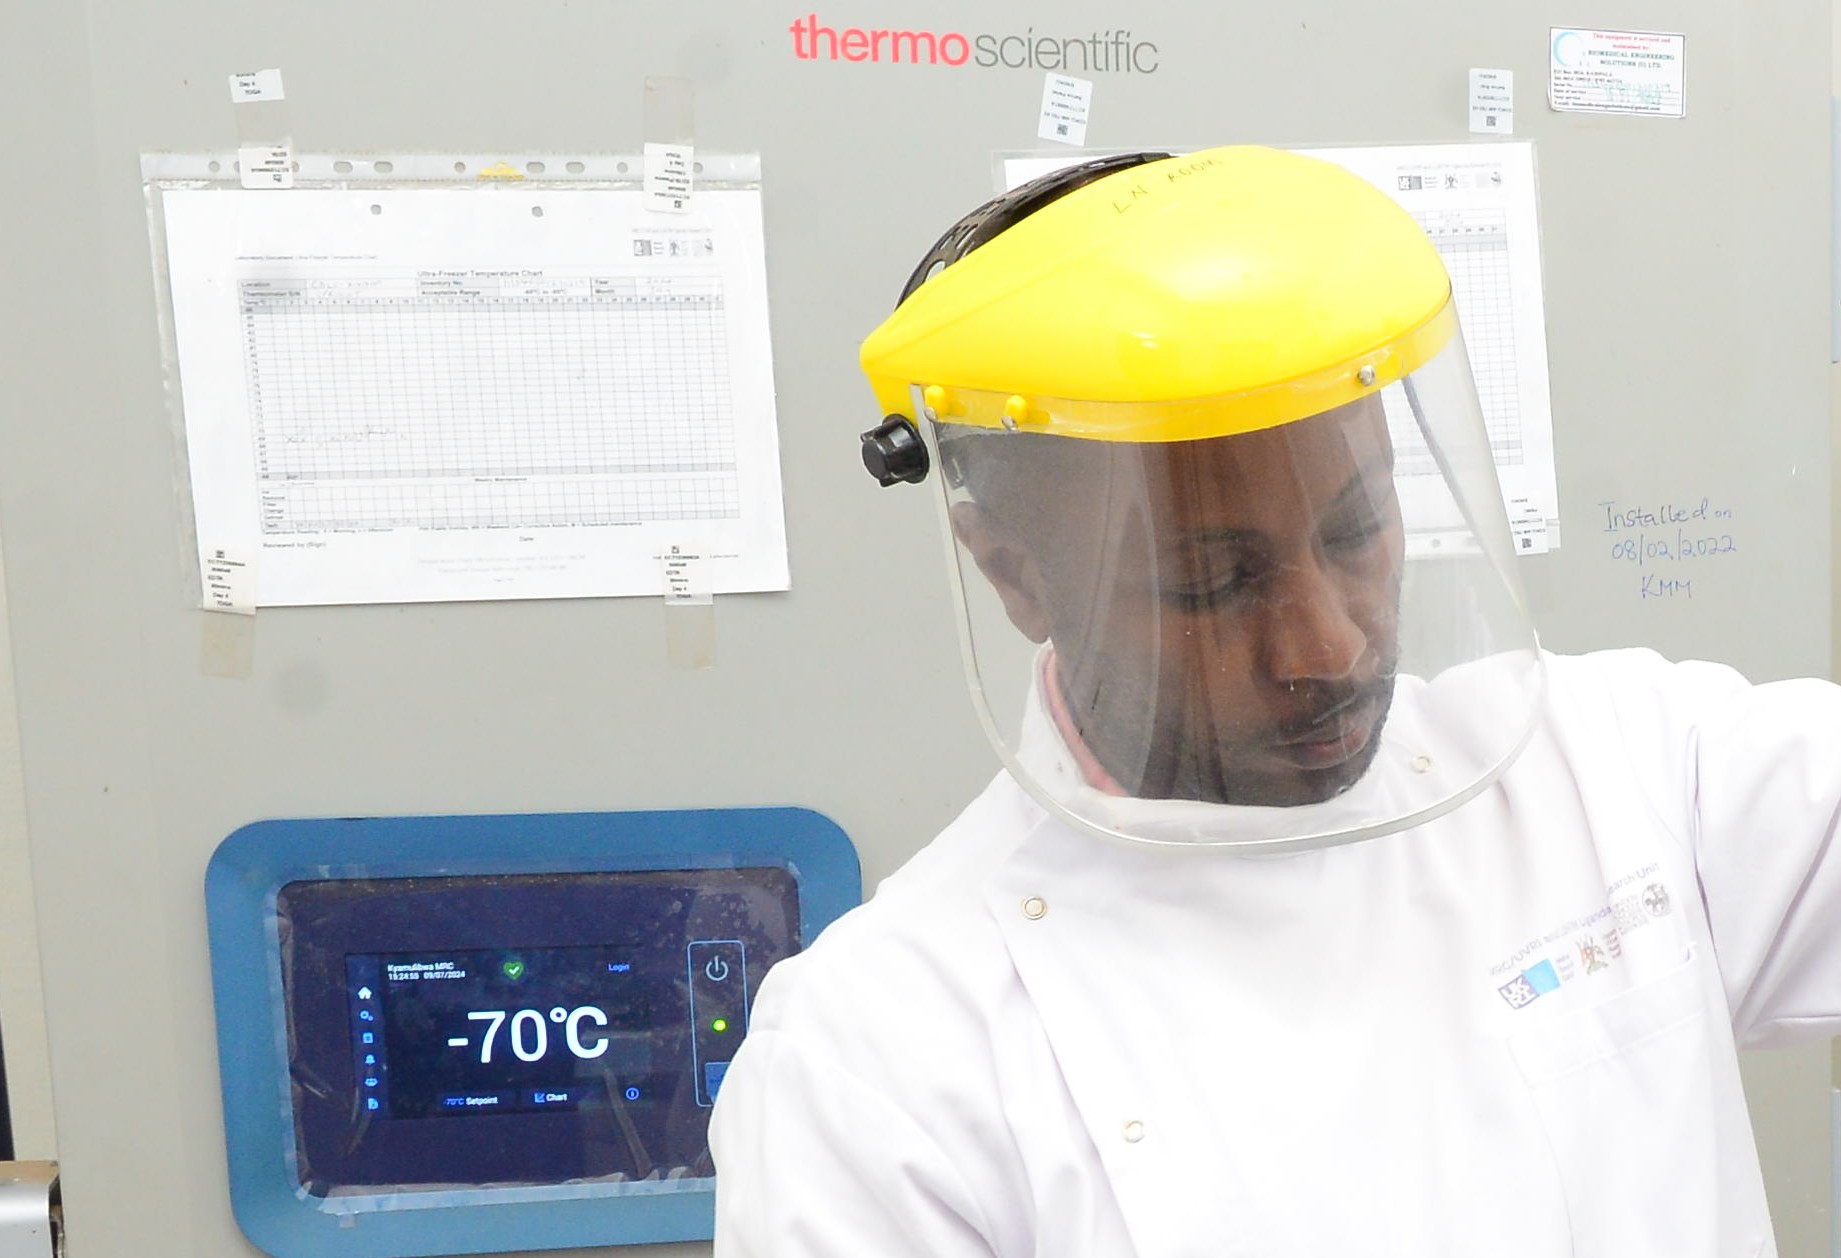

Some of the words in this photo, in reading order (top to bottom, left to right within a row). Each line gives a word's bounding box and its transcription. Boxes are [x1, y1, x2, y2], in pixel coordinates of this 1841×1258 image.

[1588, 50, 1628, 58] BIOMEDICAL
[1630, 52, 1674, 61] ENGINEERING
[470, 270, 519, 278] Temperature
[1598, 498, 1709, 532] Installed
[435, 962, 455, 971] MRC
[608, 963, 630, 973] Login
[448, 1006, 609, 1063] -70°C
[466, 1096, 498, 1107] Setpoint
[546, 1093, 568, 1101] Chart
